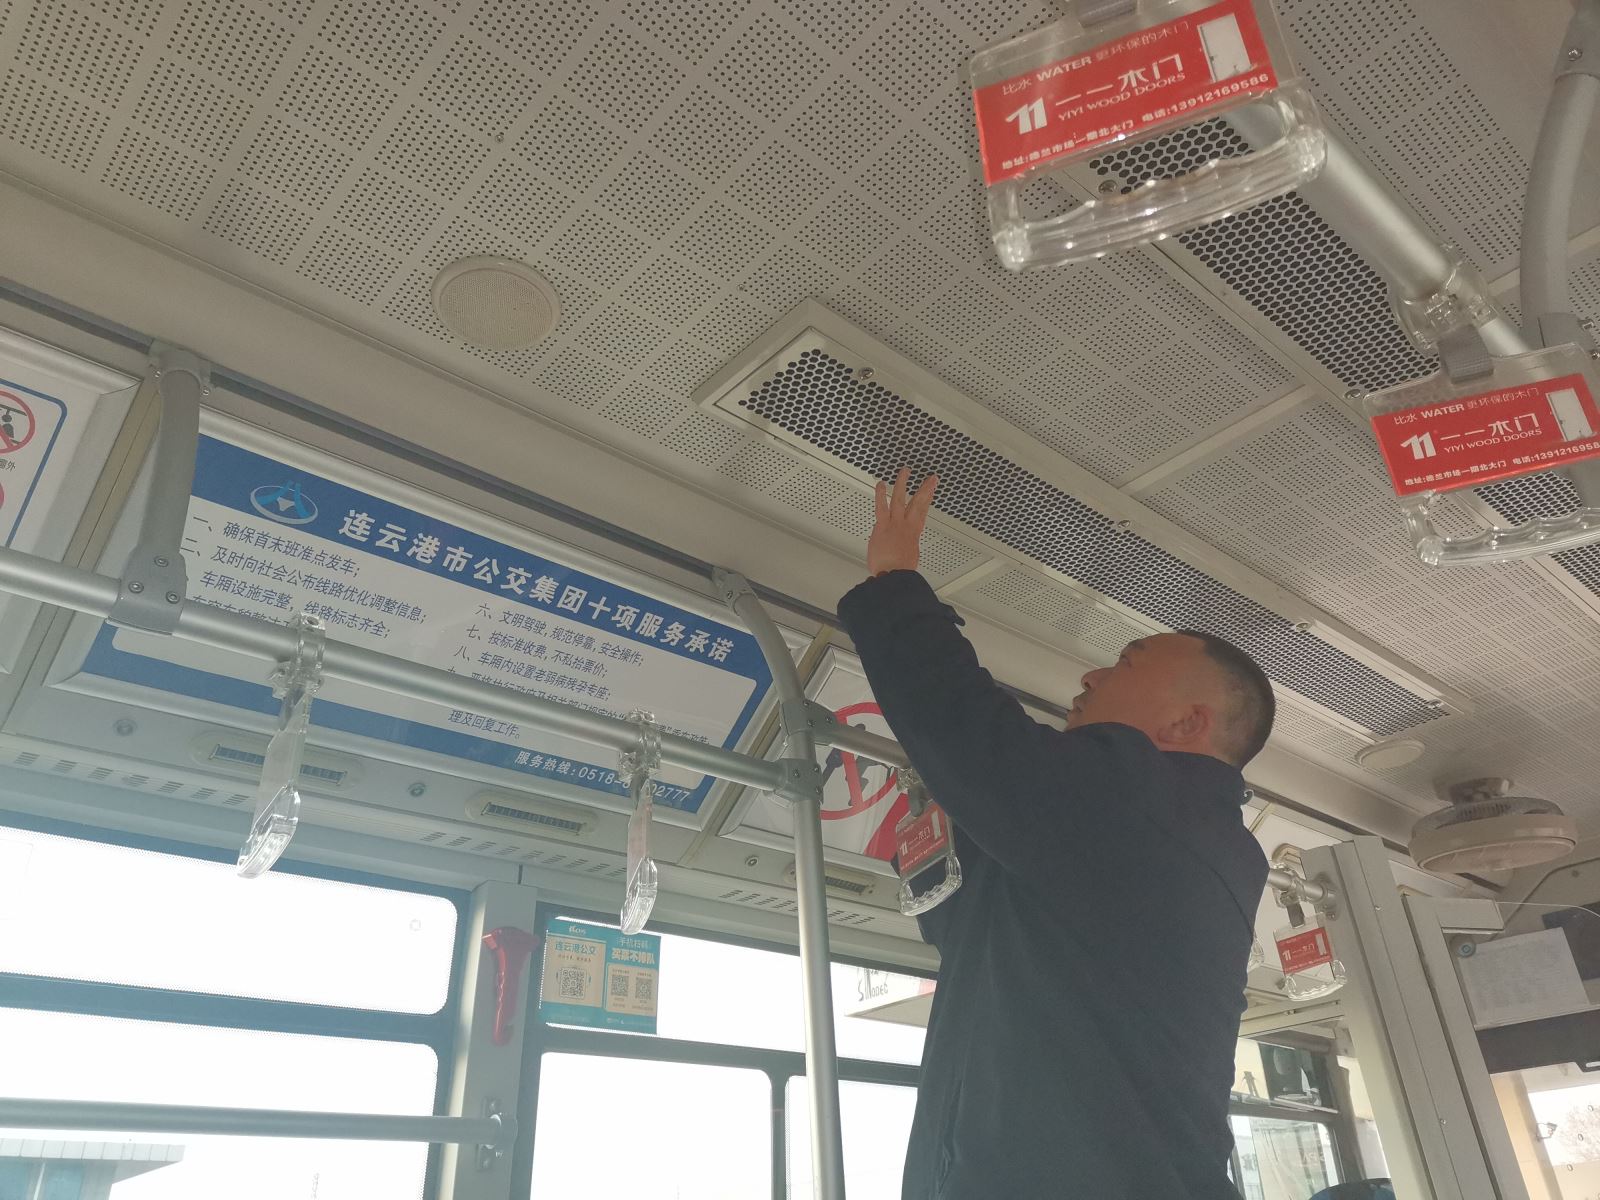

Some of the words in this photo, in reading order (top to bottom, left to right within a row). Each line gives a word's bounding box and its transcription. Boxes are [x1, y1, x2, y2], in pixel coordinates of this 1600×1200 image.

[1037, 56, 1092, 82] WATER
[1058, 106, 1084, 121] YIYI
[1087, 93, 1131, 111] WOOD
[1135, 73, 1186, 95] DOORS
[1421, 404, 1465, 419] WATER
[1444, 445, 1464, 453] YIYI
[1466, 438, 1500, 449] WOOD
[1504, 429, 1542, 442] DOORS
[338, 509, 734, 664] 连云港市公交集团十项服务承诺
